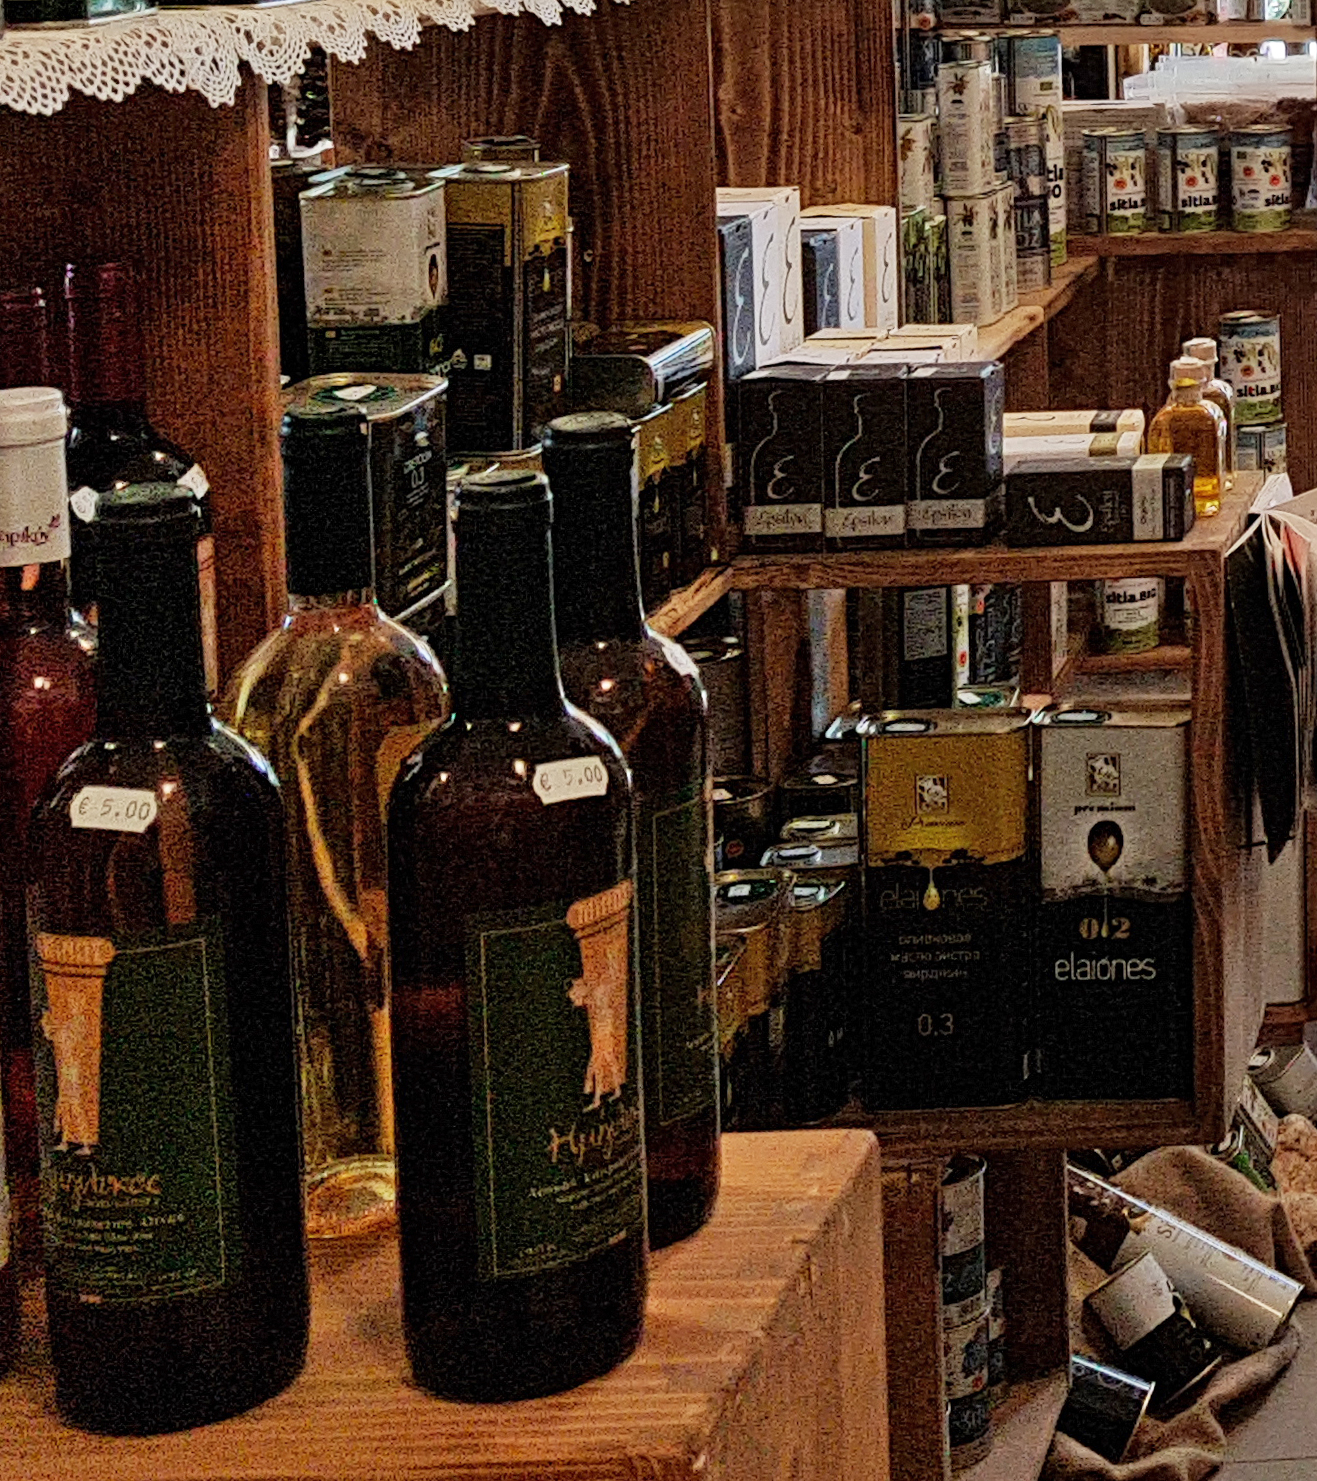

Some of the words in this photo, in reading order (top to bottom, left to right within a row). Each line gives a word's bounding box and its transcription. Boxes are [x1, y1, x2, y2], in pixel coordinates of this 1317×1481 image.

[563, 763, 605, 787] 5.00
[99, 798, 152, 821] 5.00
[1074, 802, 1137, 816] premium
[917, 1013, 955, 1038] 0.3
